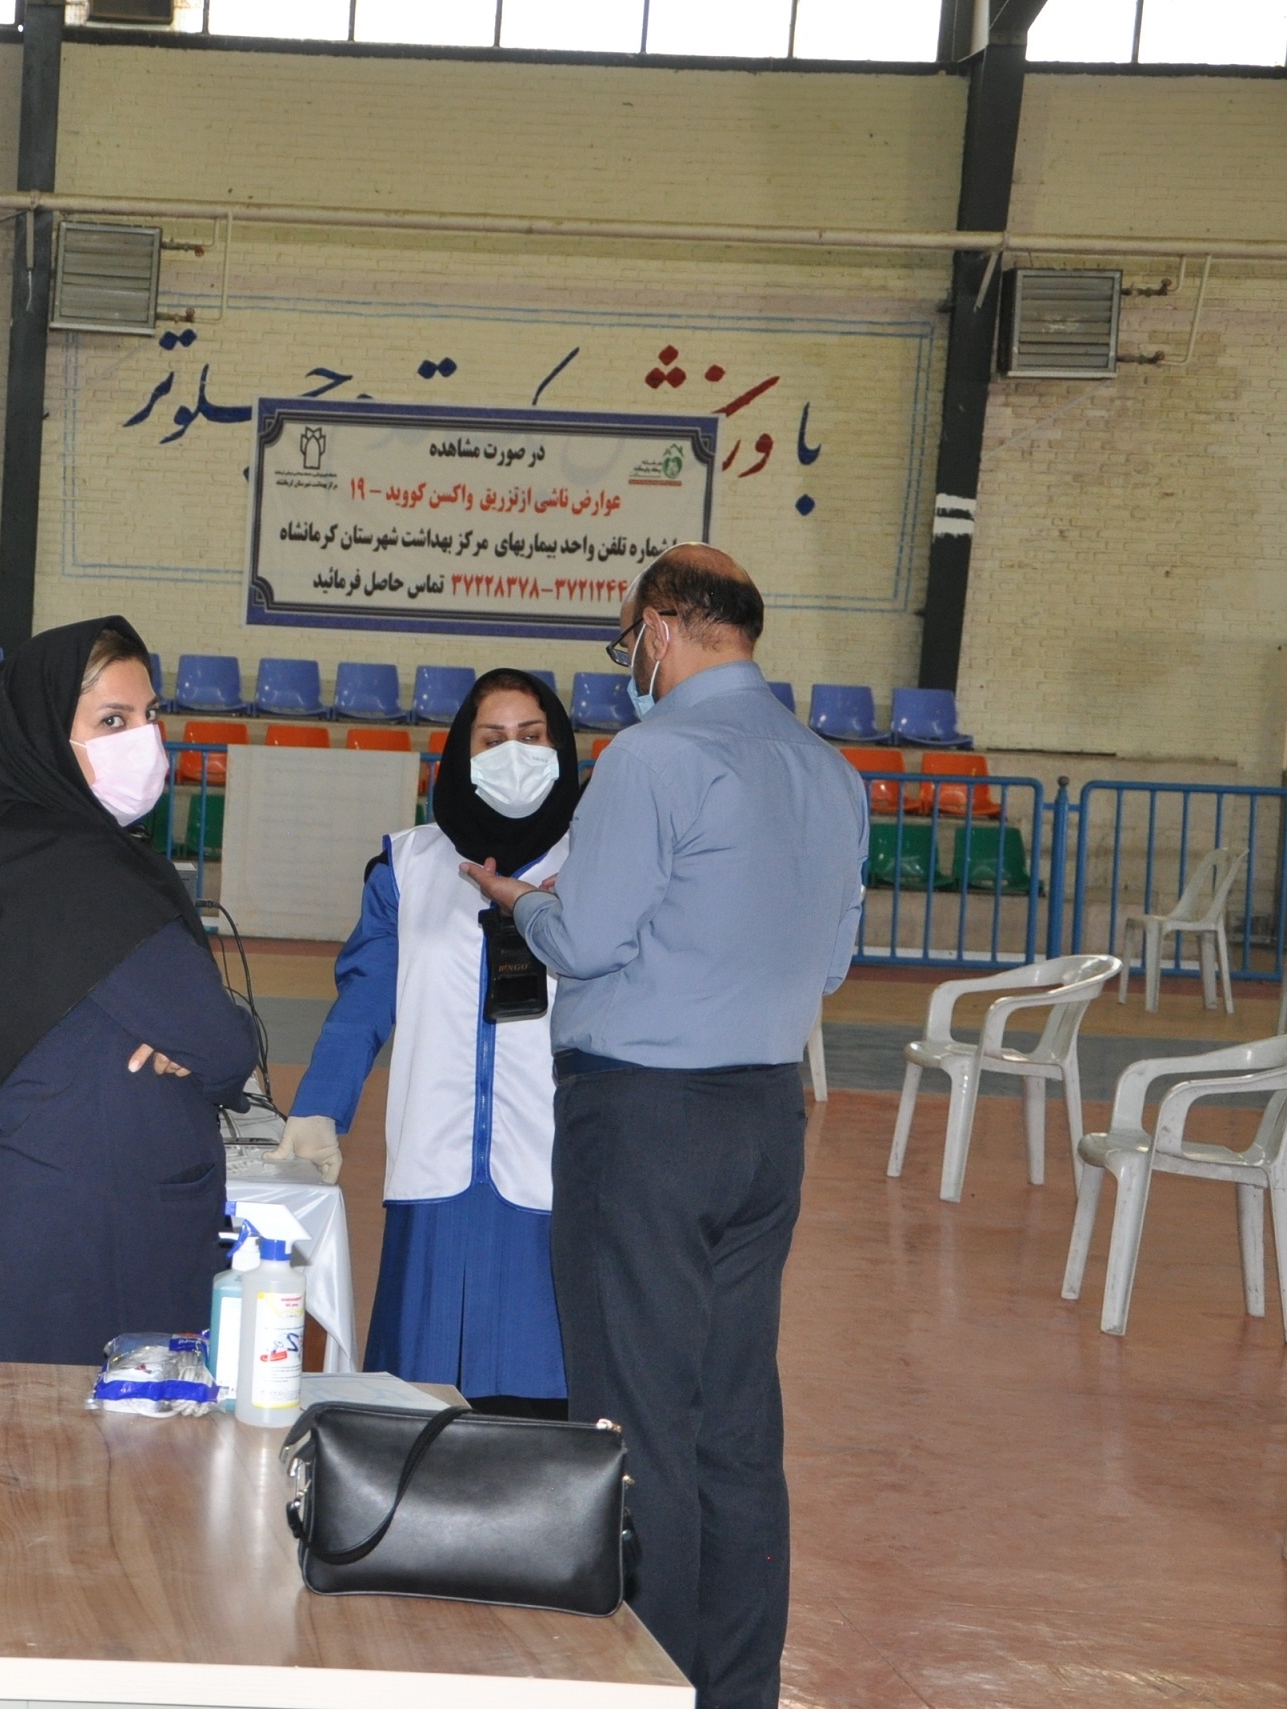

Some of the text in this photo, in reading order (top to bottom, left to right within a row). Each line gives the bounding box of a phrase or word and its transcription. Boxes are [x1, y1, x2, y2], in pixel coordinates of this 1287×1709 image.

[429, 437, 546, 467] در صورت مشاهده
[795, 400, 822, 516] با
[350, 476, 365, 501] ۱۹
[385, 481, 427, 508] کووید
[429, 483, 474, 511] واکسن
[534, 486, 569, 513] ناشی
[571, 489, 621, 516] عوارض
[279, 520, 339, 550] کرمانشاه
[340, 524, 399, 552] شهرستان
[401, 527, 453, 553] بهداشت
[455, 529, 489, 557] مرکز
[494, 531, 557, 558] بیماریهای
[562, 534, 595, 562] واحد
[597, 536, 627, 562] تلفن
[364, 571, 404, 597] حاصل
[407, 573, 445, 599] تماس
